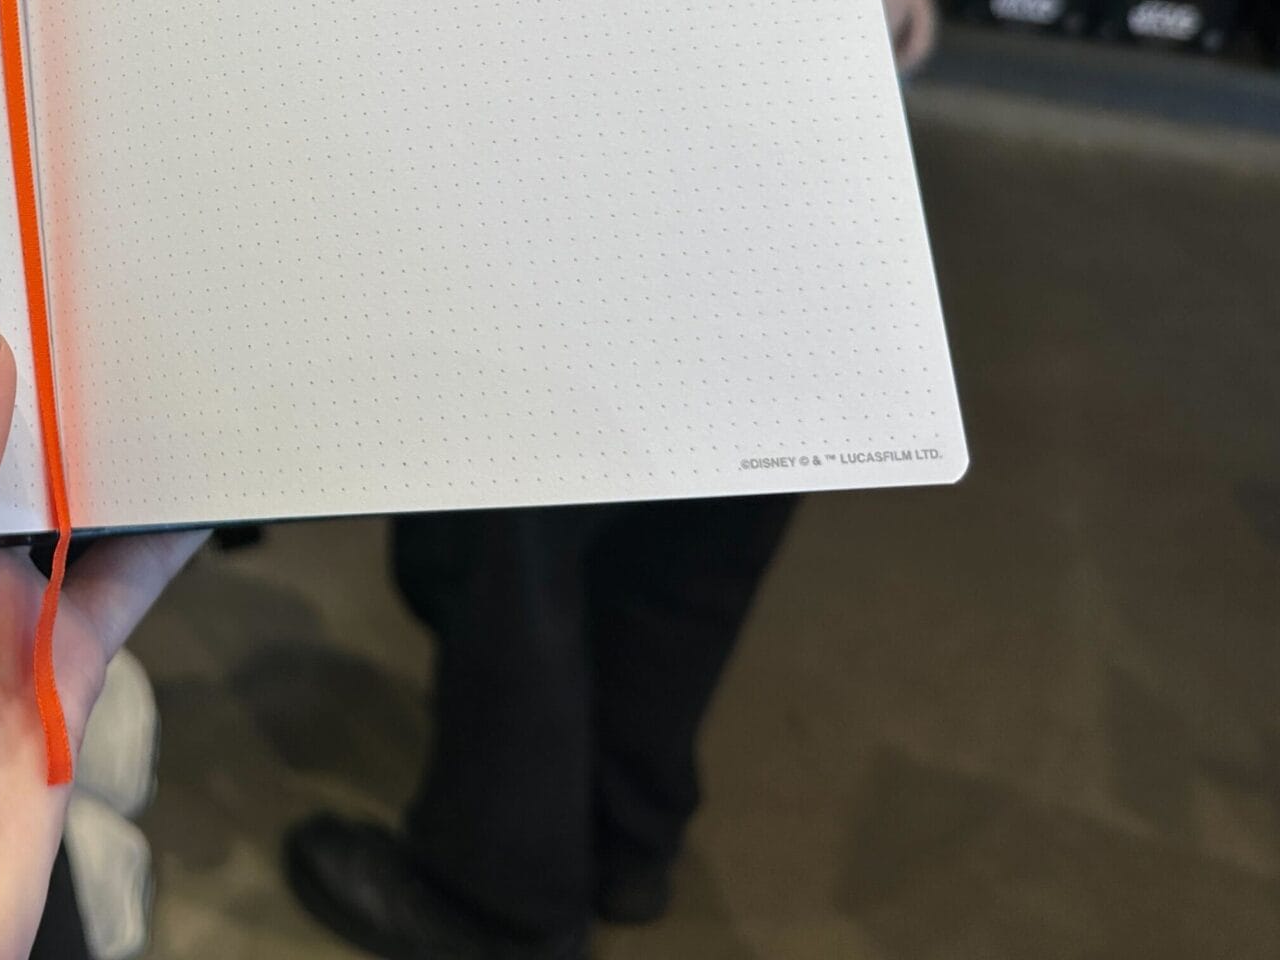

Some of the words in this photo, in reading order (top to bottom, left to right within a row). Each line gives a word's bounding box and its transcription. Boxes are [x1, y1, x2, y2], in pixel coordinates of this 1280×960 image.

[812, 455, 822, 467] &
[839, 450, 912, 465] LUCASFILM
[915, 449, 944, 461] LTD.
